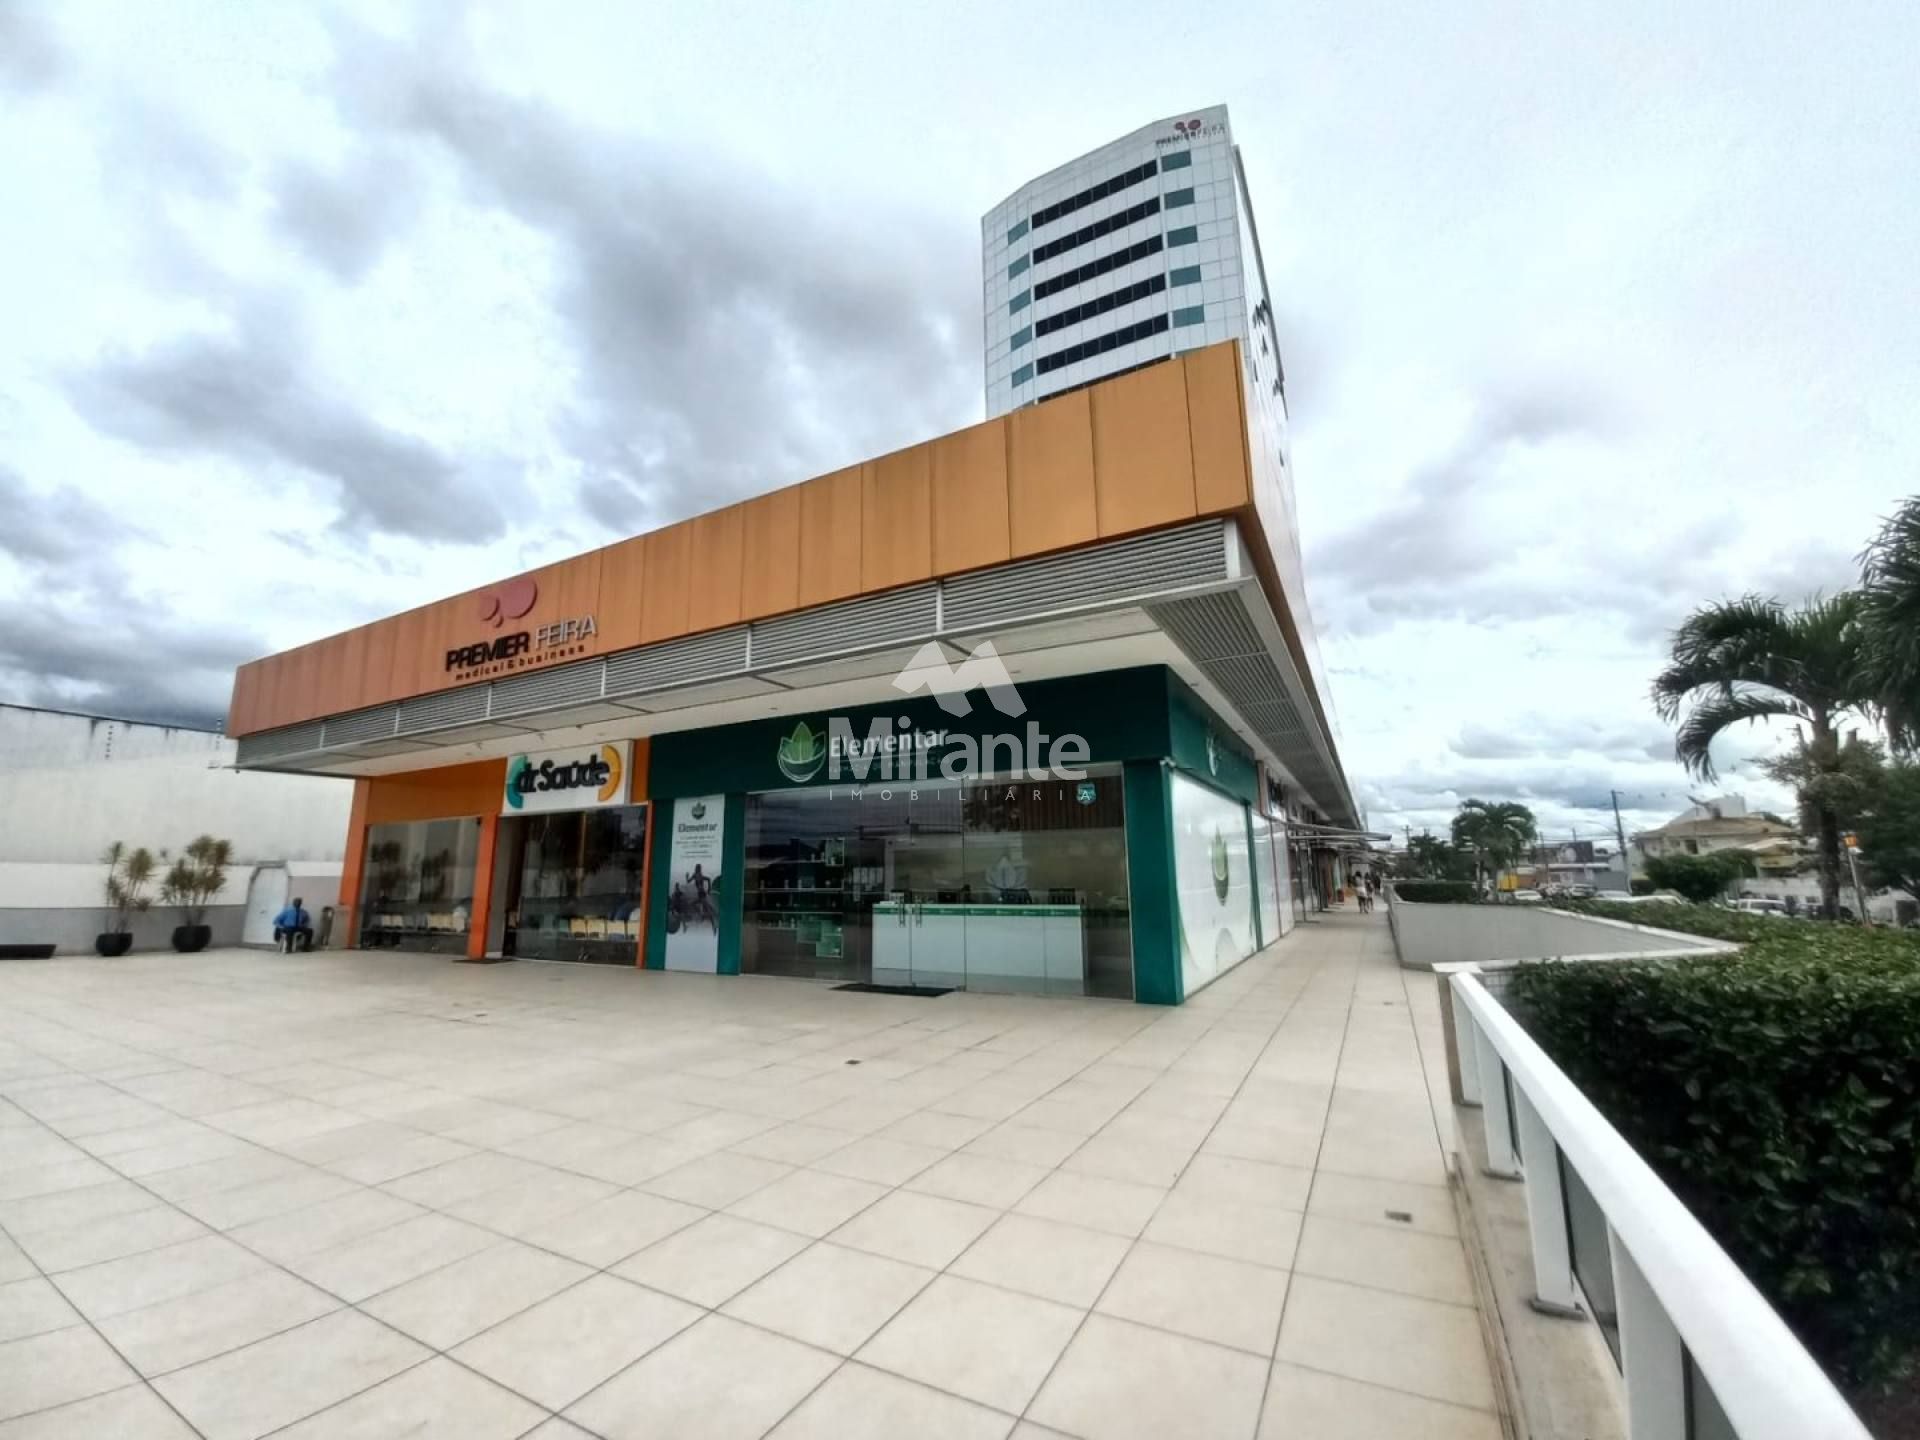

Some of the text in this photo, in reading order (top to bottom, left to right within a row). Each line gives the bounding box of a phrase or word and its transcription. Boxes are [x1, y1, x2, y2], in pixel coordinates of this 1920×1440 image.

[445, 614, 598, 672] PREMIER FEIRA
[830, 727, 949, 758] Elementar
